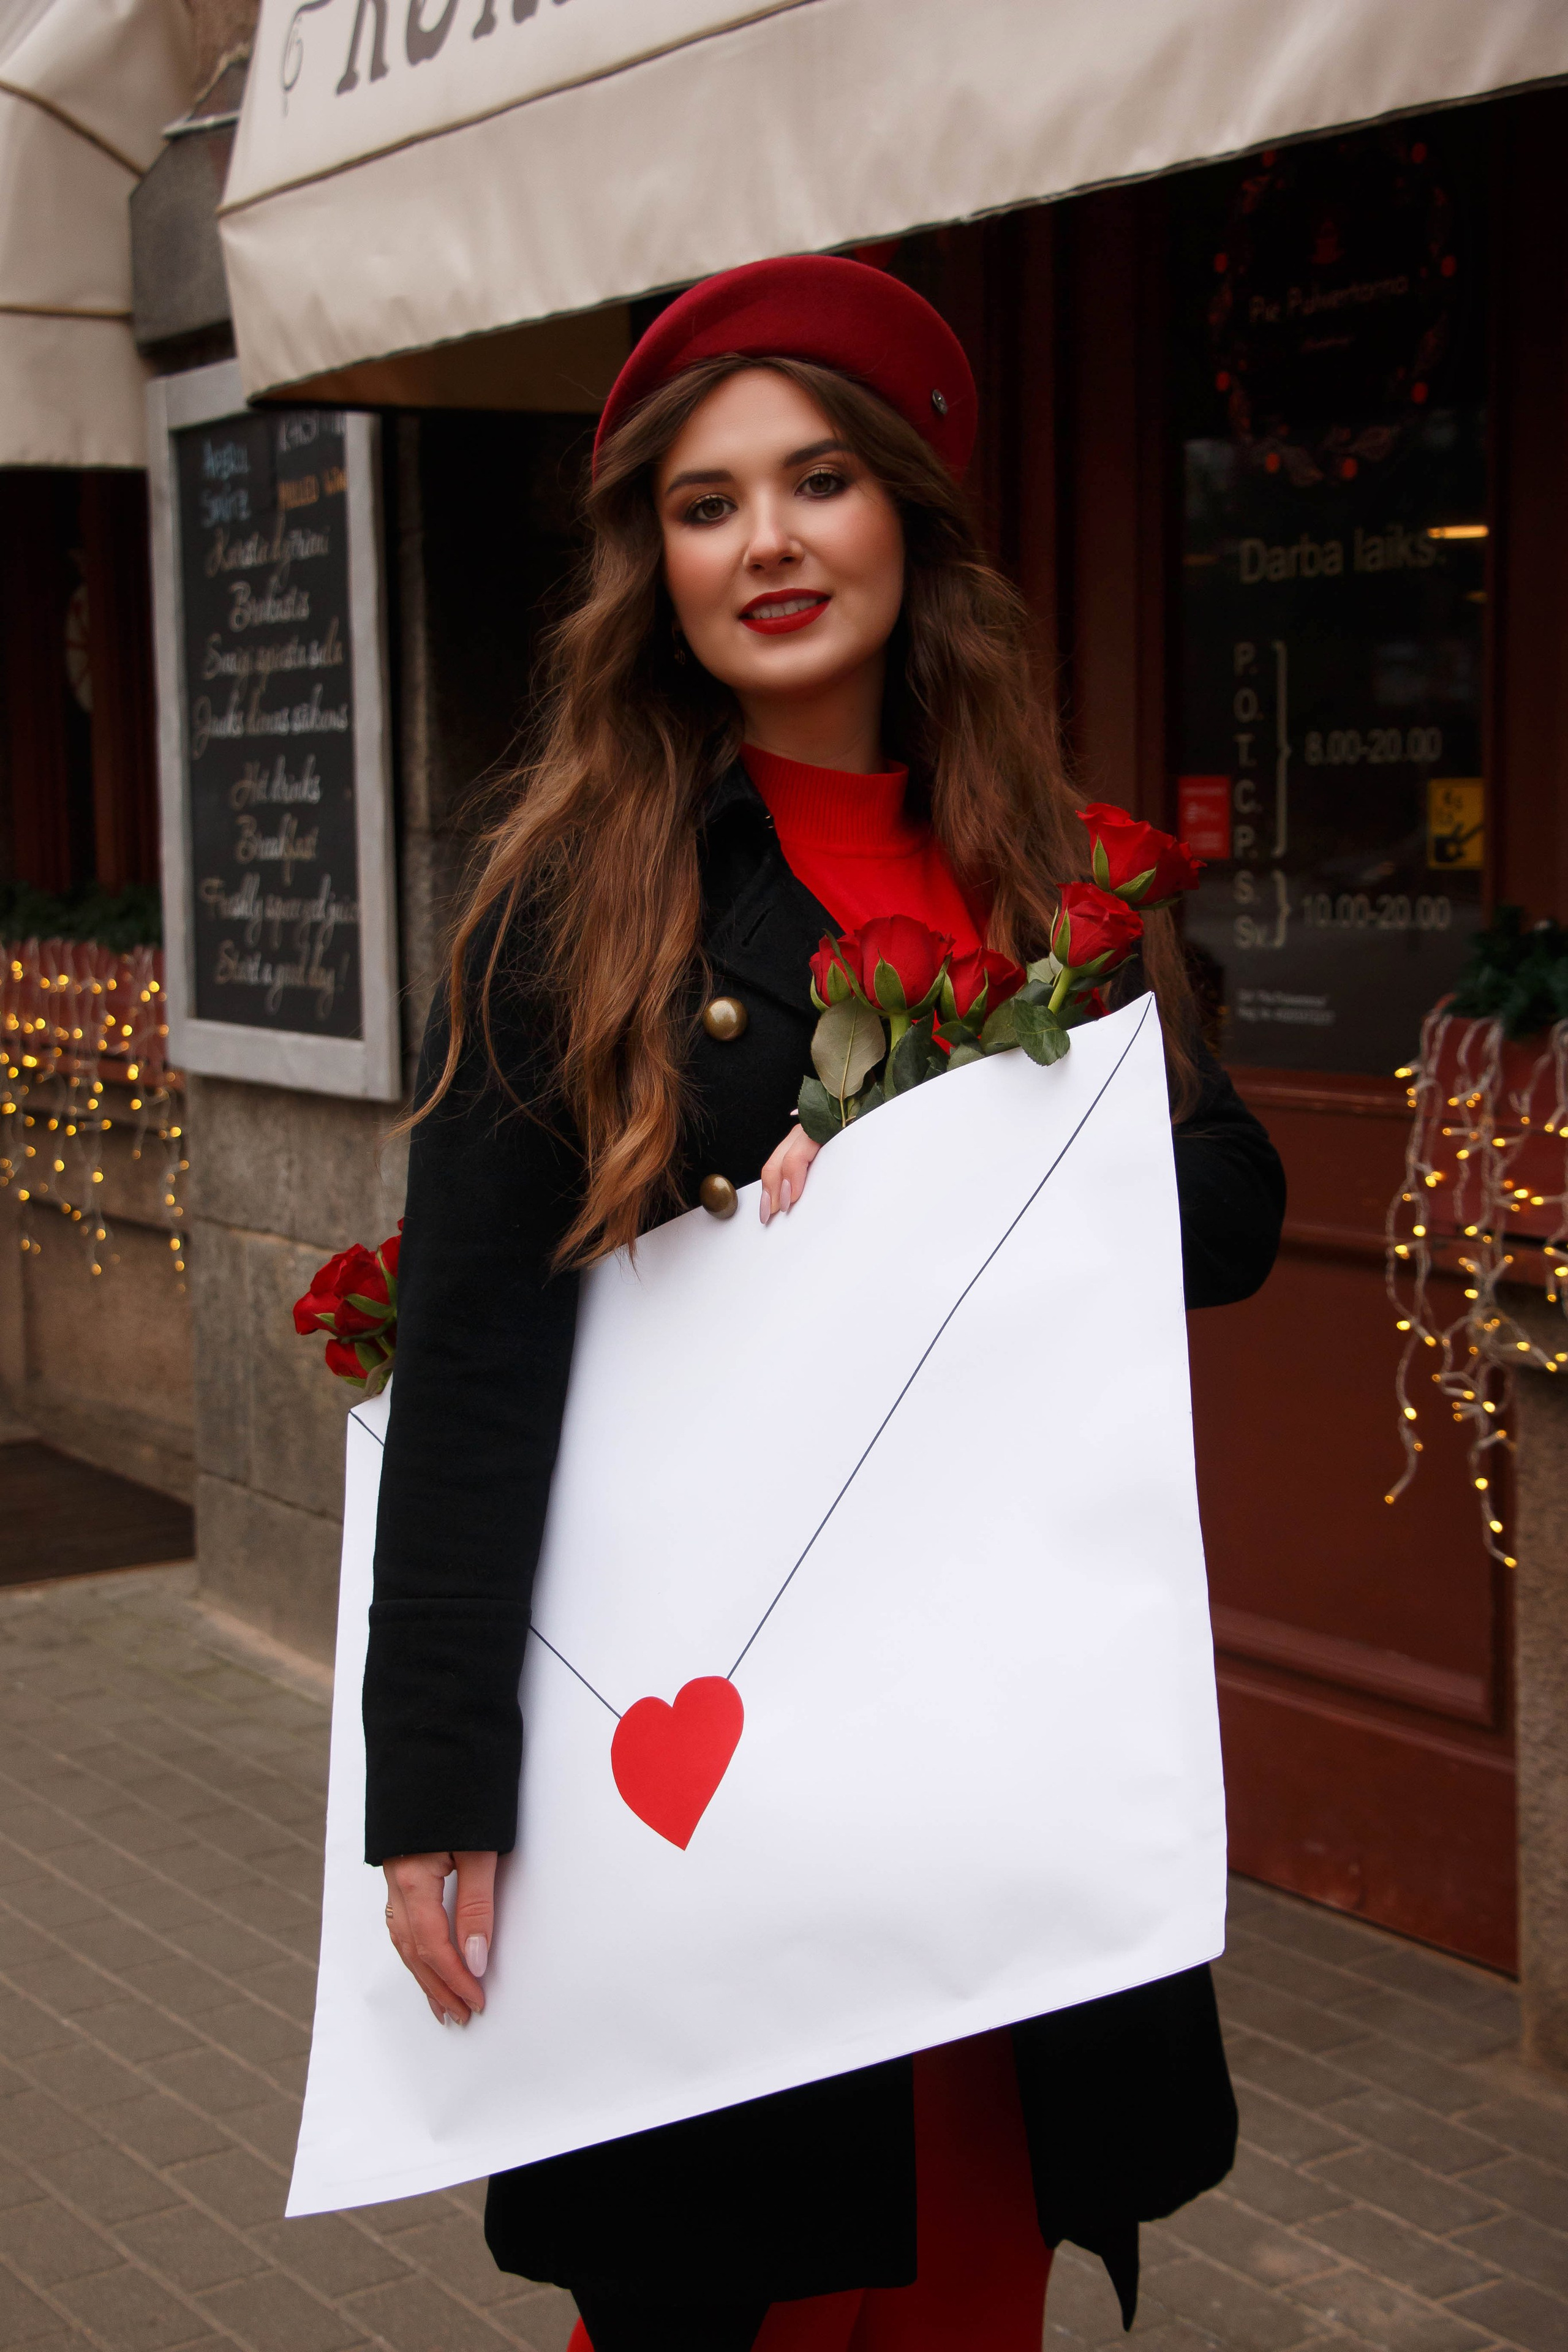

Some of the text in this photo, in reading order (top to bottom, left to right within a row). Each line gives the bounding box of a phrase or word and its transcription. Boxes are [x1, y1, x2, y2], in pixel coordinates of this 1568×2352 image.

[1239, 532, 1344, 586] Darba
[1305, 726, 1443, 767] 8.00-20.00
[1302, 894, 1452, 931] 10.00-20.00
